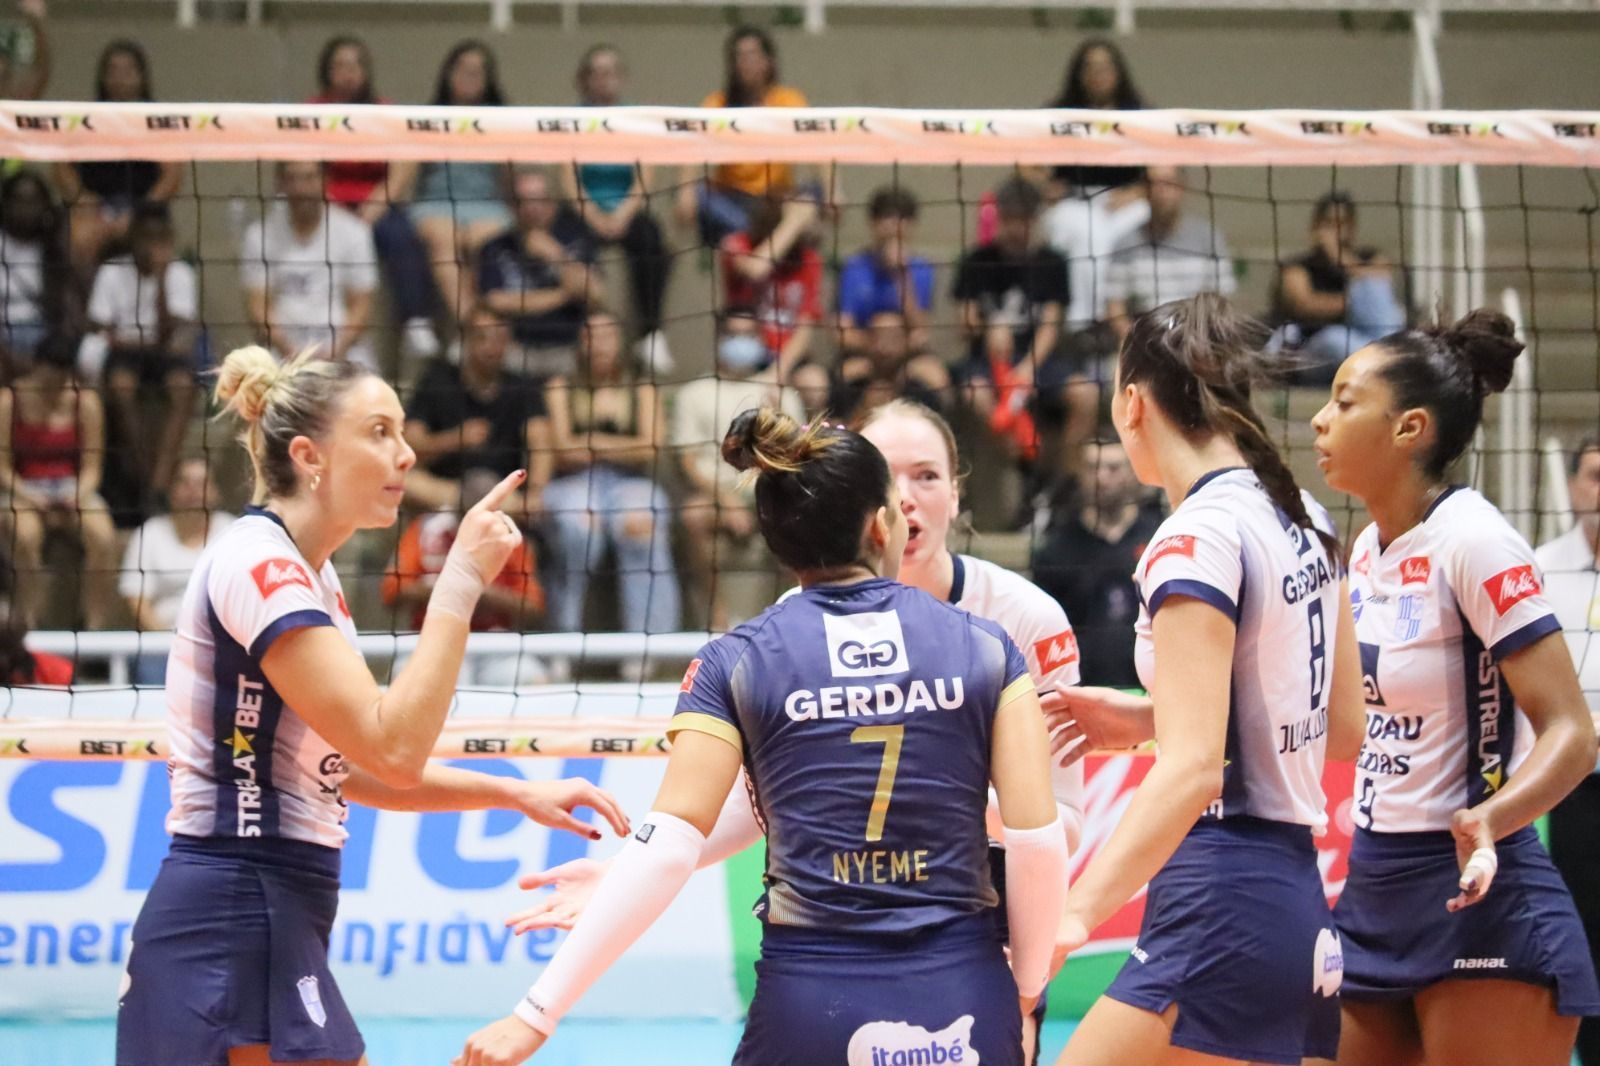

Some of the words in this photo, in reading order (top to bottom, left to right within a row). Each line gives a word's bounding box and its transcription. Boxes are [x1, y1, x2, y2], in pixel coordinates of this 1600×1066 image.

[1553, 122, 1600, 138] BET
[1308, 597, 1325, 710] 8
[234, 673, 265, 729] BET
[785, 676, 964, 722] GERDAU
[1366, 713, 1423, 741] DAU
[850, 724, 904, 842] 7
[1357, 744, 1411, 776] inas
[832, 849, 930, 885] NYEME
[0, 920, 132, 966] ener
